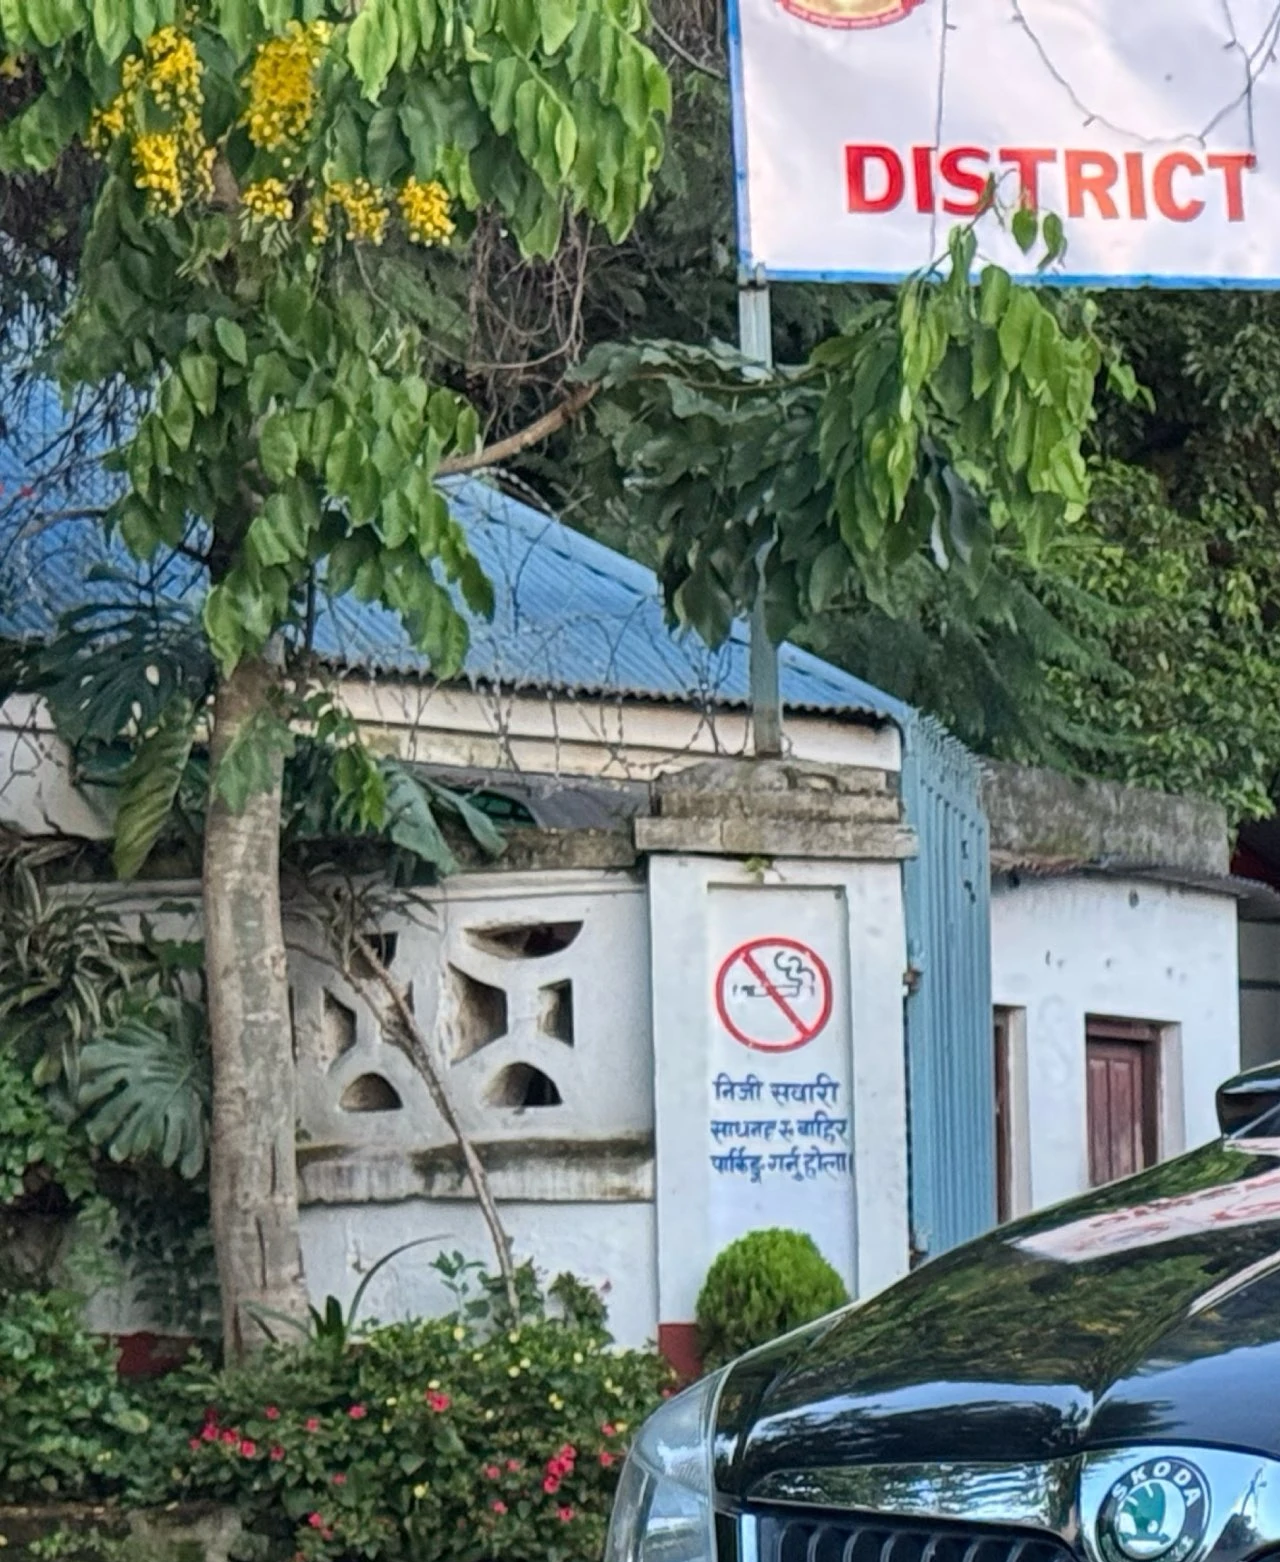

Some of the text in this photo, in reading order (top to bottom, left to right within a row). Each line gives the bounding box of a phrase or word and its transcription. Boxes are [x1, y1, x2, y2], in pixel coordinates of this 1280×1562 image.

[844, 144, 1257, 223] DISTRICT
[712, 1072, 840, 1109] निजी सवारी
